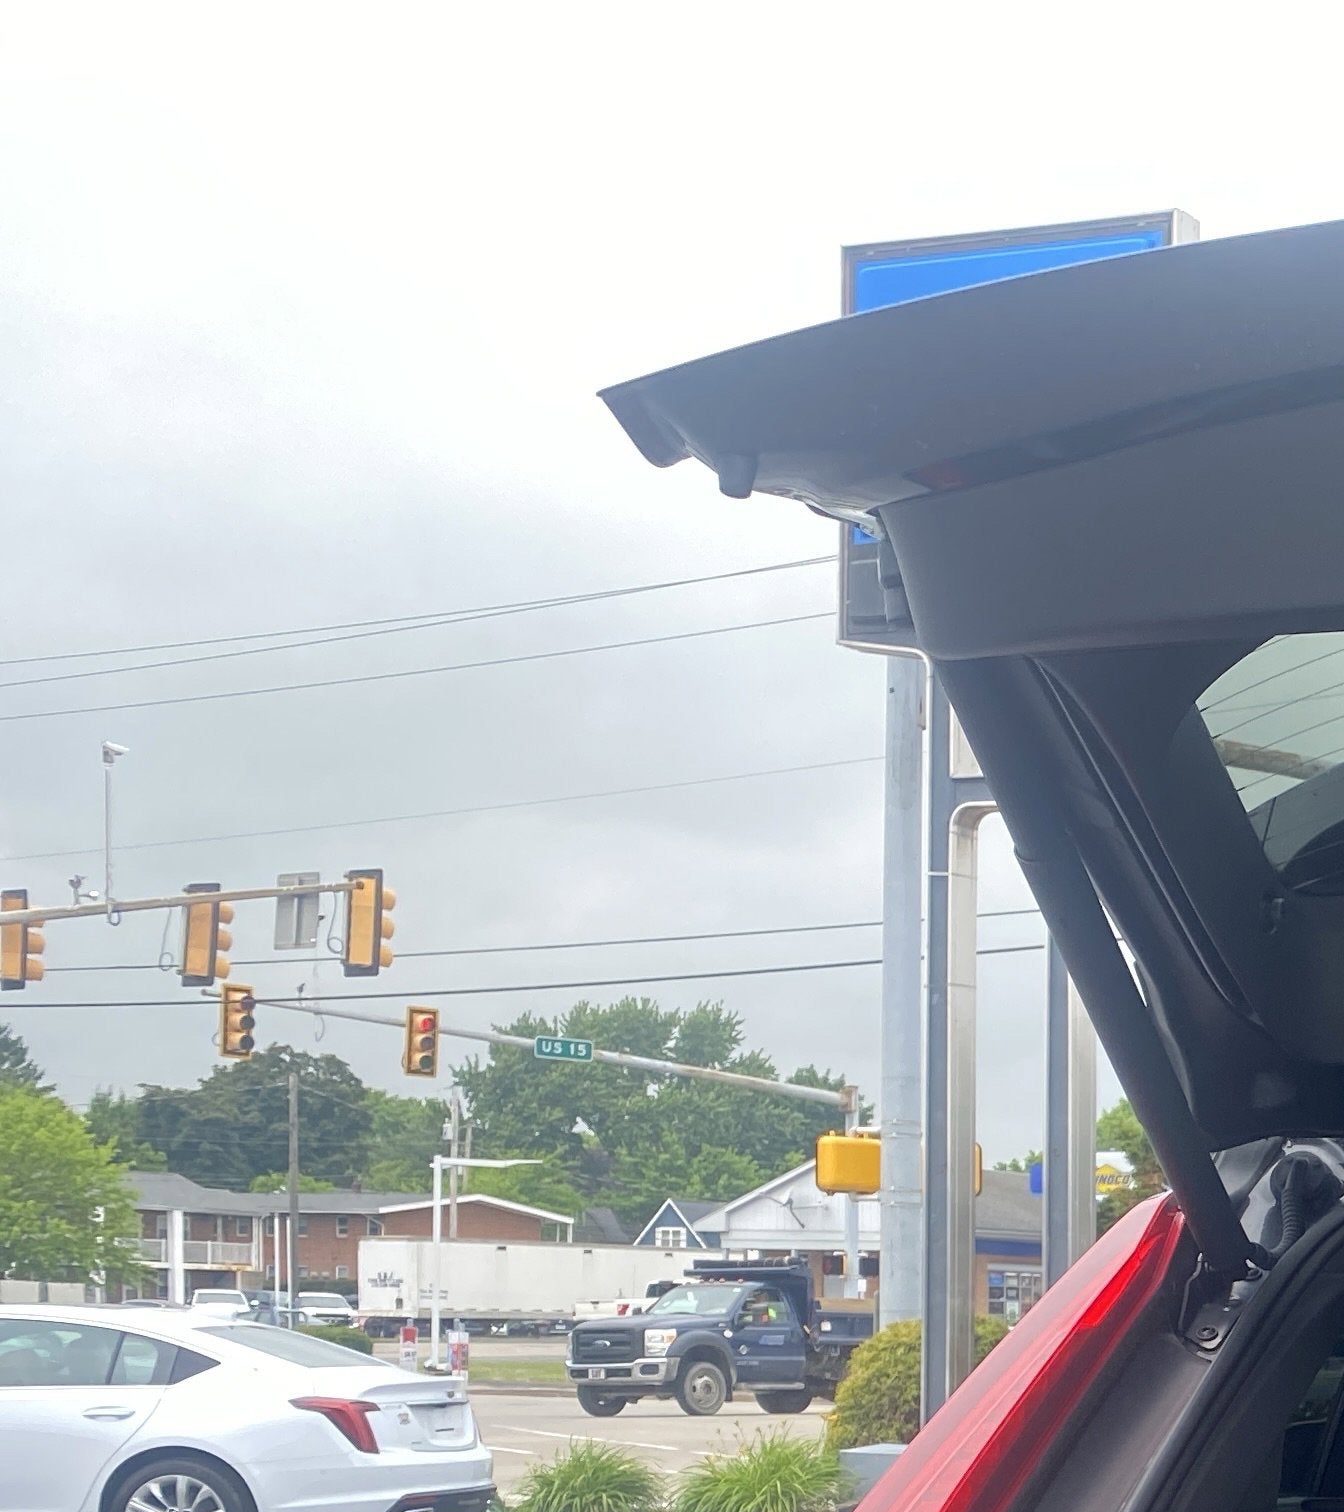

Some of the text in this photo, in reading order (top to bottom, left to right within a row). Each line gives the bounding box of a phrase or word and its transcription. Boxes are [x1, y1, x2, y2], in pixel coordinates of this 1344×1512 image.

[541, 1040, 587, 1056] US 15
[1096, 1174, 1130, 1185] NOCO
